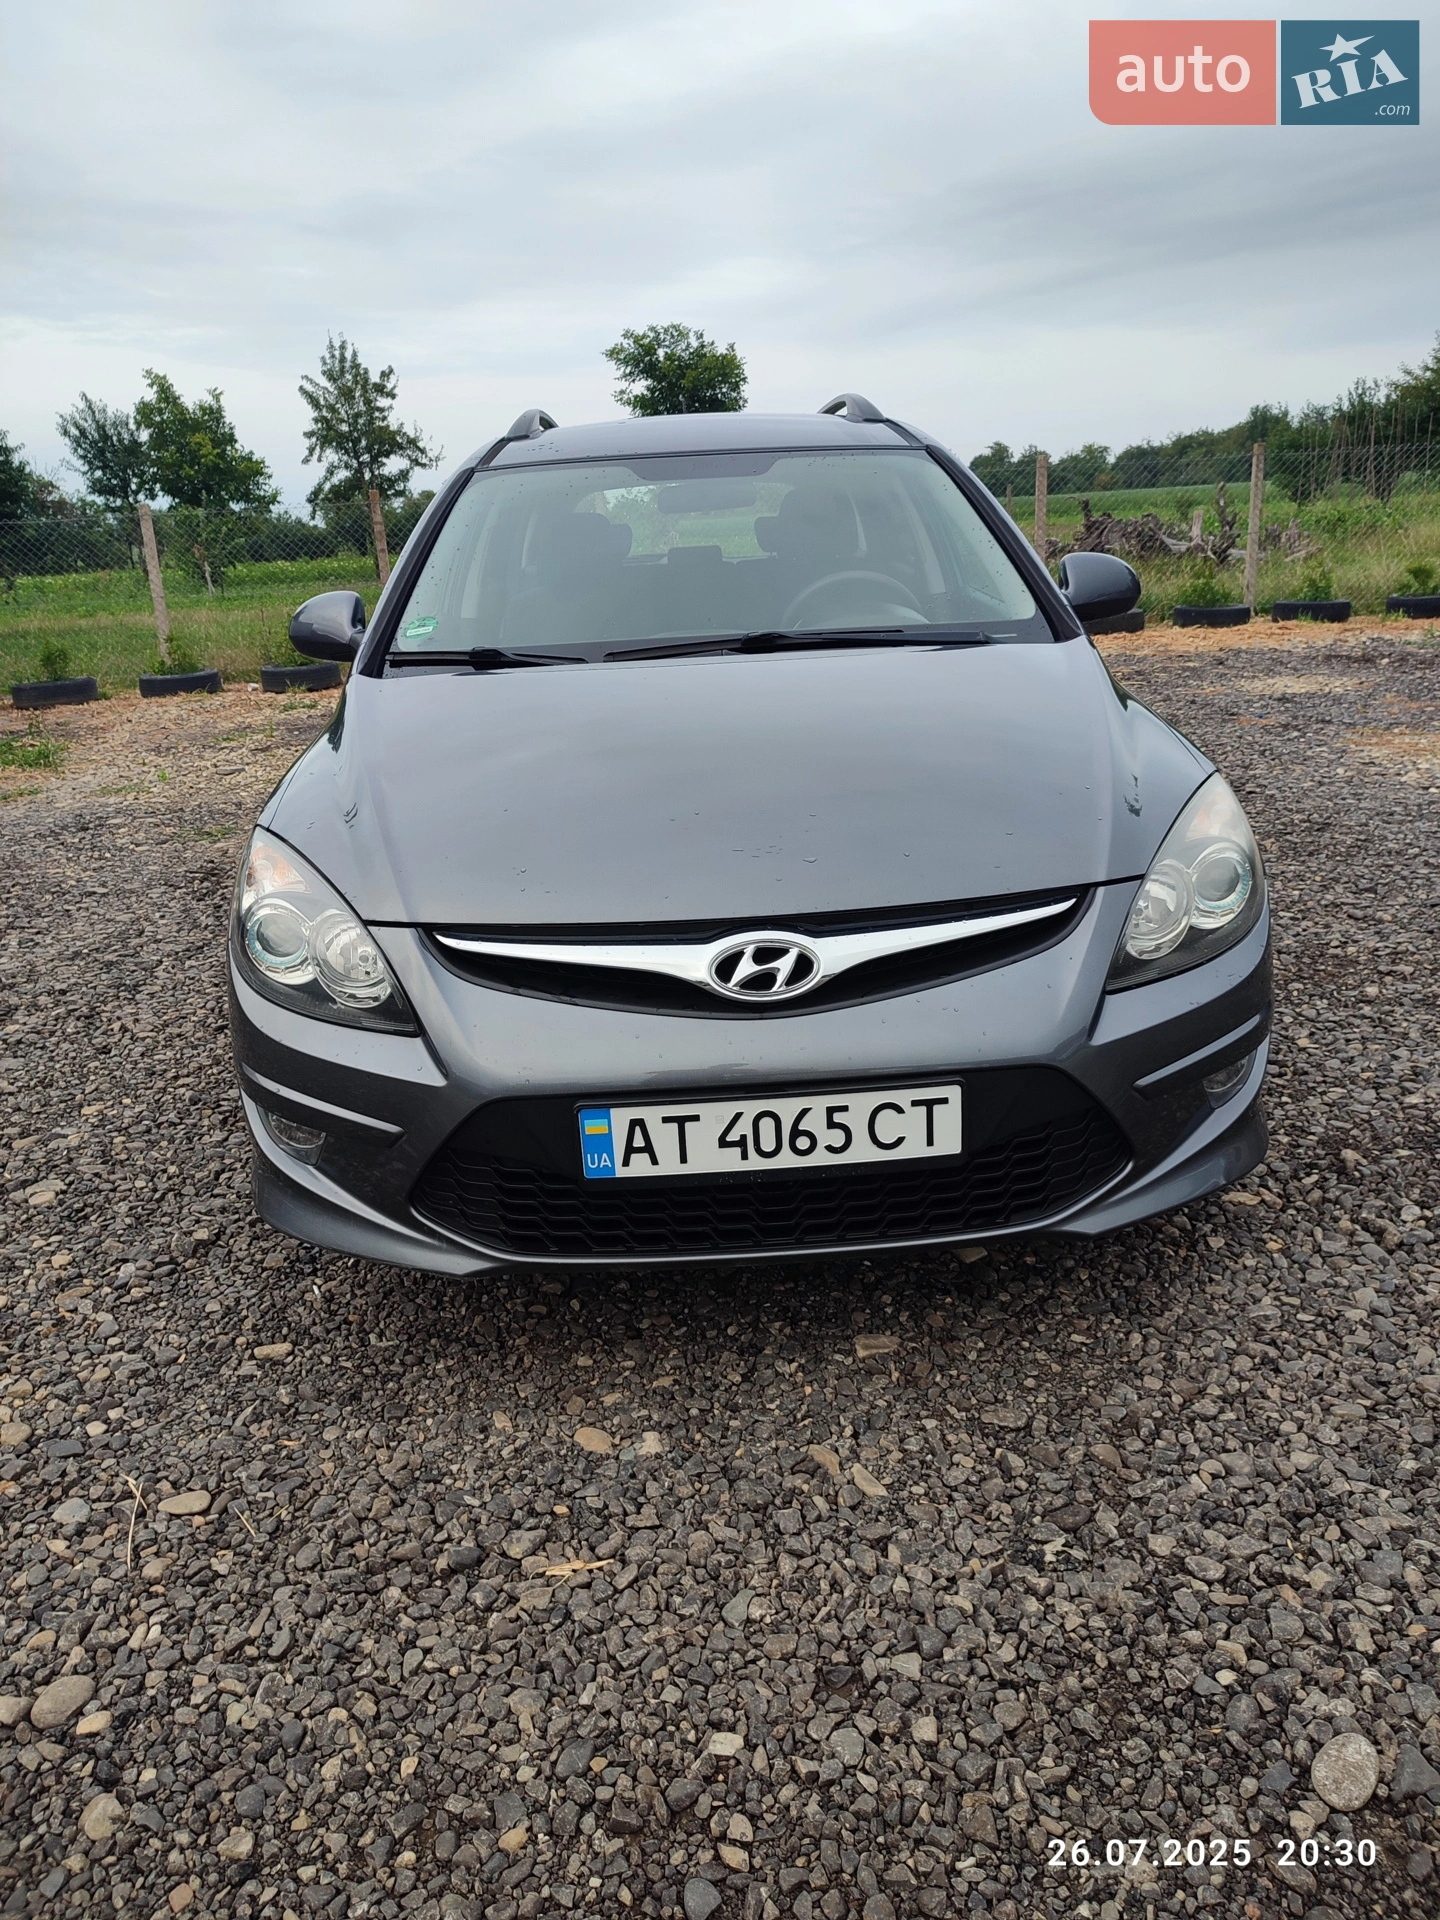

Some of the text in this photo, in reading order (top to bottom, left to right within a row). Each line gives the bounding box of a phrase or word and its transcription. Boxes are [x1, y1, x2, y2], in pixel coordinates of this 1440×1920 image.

[621, 1096, 950, 1168] AT 4065 CT
[587, 1153, 612, 1169] UA
